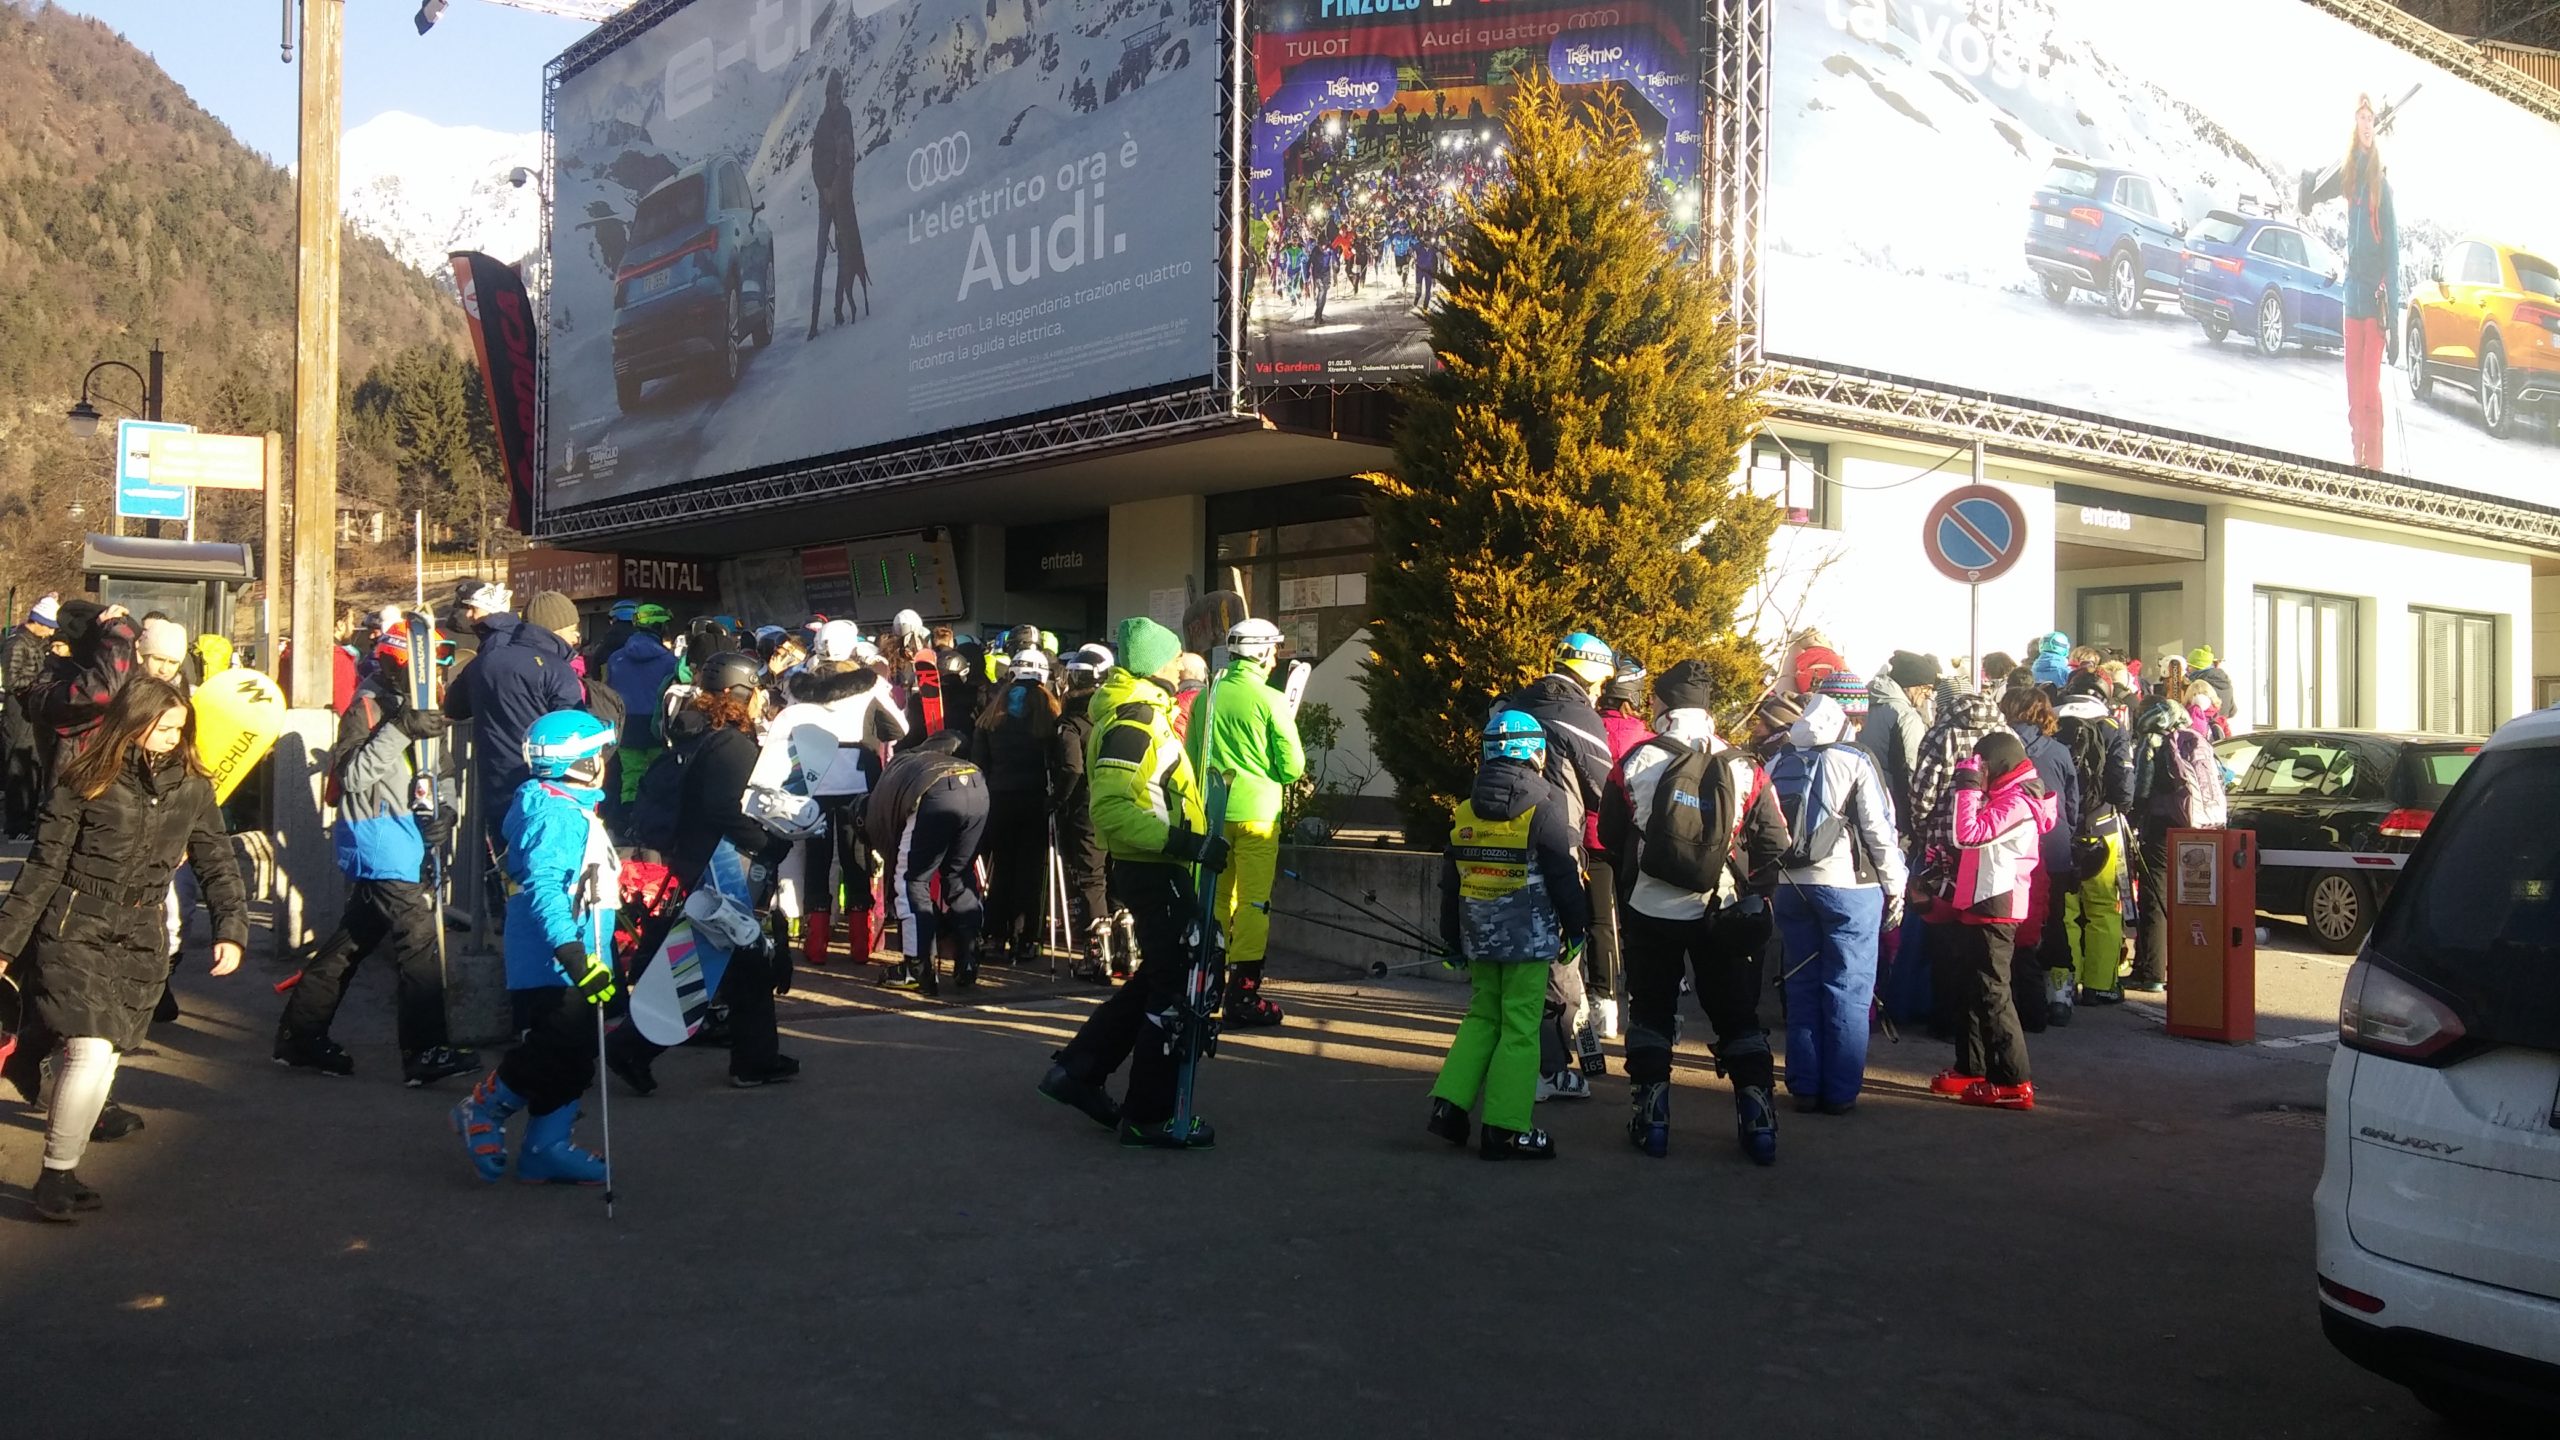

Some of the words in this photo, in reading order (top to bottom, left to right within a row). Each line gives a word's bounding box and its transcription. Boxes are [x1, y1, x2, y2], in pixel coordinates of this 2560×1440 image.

[1422, 27, 1471, 48] Audi
[1477, 21, 1560, 45] quattro
[1285, 38, 1350, 58] TULOT
[1565, 45, 1622, 67] TRENTINO
[1325, 79, 1379, 98] TRENTINO
[1265, 111, 1303, 126] TRENTINO
[1056, 150, 1107, 191] ora
[1119, 131, 1139, 168] è
[957, 181, 1127, 302] Audi.
[909, 331, 934, 350] Audi
[936, 320, 976, 343] e-tron.
[978, 315, 994, 333] La
[995, 292, 1071, 328] leggendaria
[1074, 276, 1131, 306] trazione
[1135, 260, 1192, 291] quattro
[908, 346, 955, 373] incontra
[957, 343, 969, 361] la
[971, 333, 1005, 361] guida
[1008, 320, 1065, 348] elettrica.
[1255, 362, 1272, 374] Val
[1275, 361, 1322, 374] Gardena
[1400, 363, 1424, 371] Gardena
[2081, 506, 2131, 531] entrata
[1041, 550, 1083, 570] entrata
[556, 565, 571, 592] SKI
[573, 559, 612, 591] SERVICE
[624, 558, 704, 592] RENTAL
[1574, 650, 1613, 666] uvex
[1481, 848, 1508, 857] COZZIO
[2095, 990, 2119, 1000] HEAD
[1582, 1019, 1598, 1053] REBELS
[1583, 1059, 1605, 1073] 165
[2359, 1125, 2465, 1155] GALAXY
